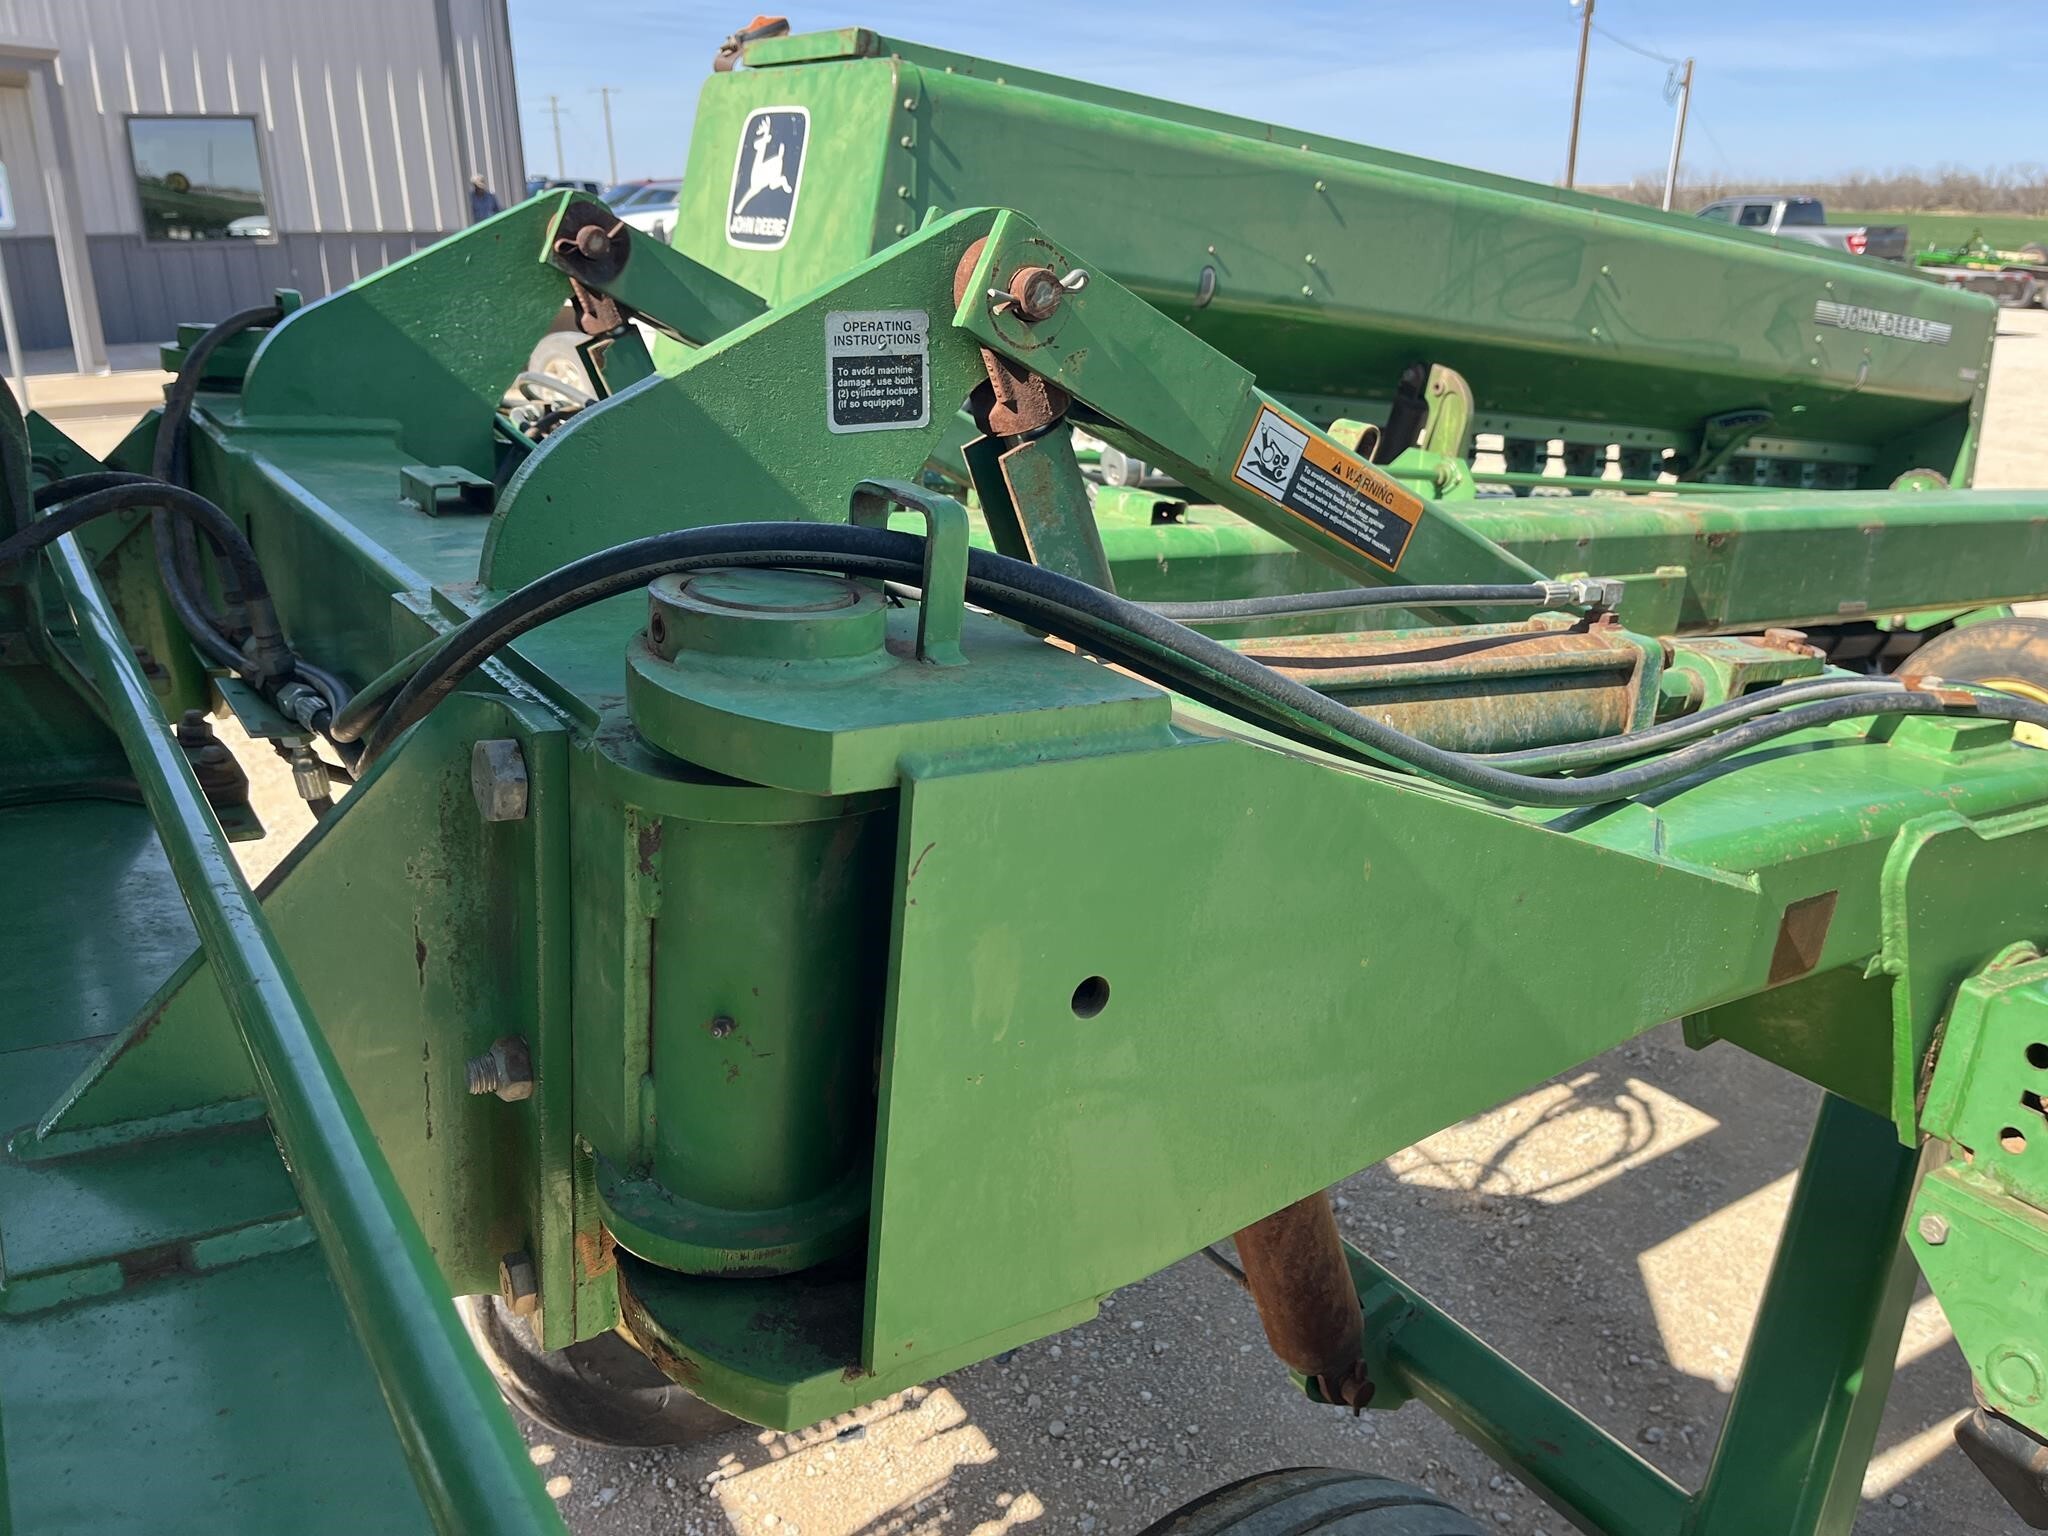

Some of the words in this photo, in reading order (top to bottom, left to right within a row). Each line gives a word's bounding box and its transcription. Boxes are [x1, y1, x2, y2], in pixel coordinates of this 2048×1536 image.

[730, 215, 755, 234] JOHN
[754, 216, 787, 237] DEERE
[843, 321, 912, 332] OPERATING
[1838, 304, 1880, 333] JOHN
[1884, 313, 1931, 343] DEERE
[833, 334, 921, 346] INSTRUCTIONS
[837, 367, 849, 377] To
[851, 366, 875, 376] avoid
[878, 366, 913, 375] machine
[876, 377, 892, 386] use
[894, 375, 914, 385] both
[837, 388, 849, 399] (2)
[850, 387, 884, 399] cylinder
[886, 385, 919, 396] lockups
[837, 399, 848, 410] (if
[849, 399, 861, 408] so
[862, 397, 905, 409] equipped)
[1304, 466, 1311, 474] To
[1311, 472, 1326, 483] avoid
[1346, 467, 1393, 504] WARNING
[1315, 485, 1333, 498] service
[1333, 494, 1346, 507] locks
[1315, 495, 1328, 506] valve
[1328, 502, 1343, 515] before
[1343, 512, 1369, 532] performing
[1369, 528, 1378, 537] any
